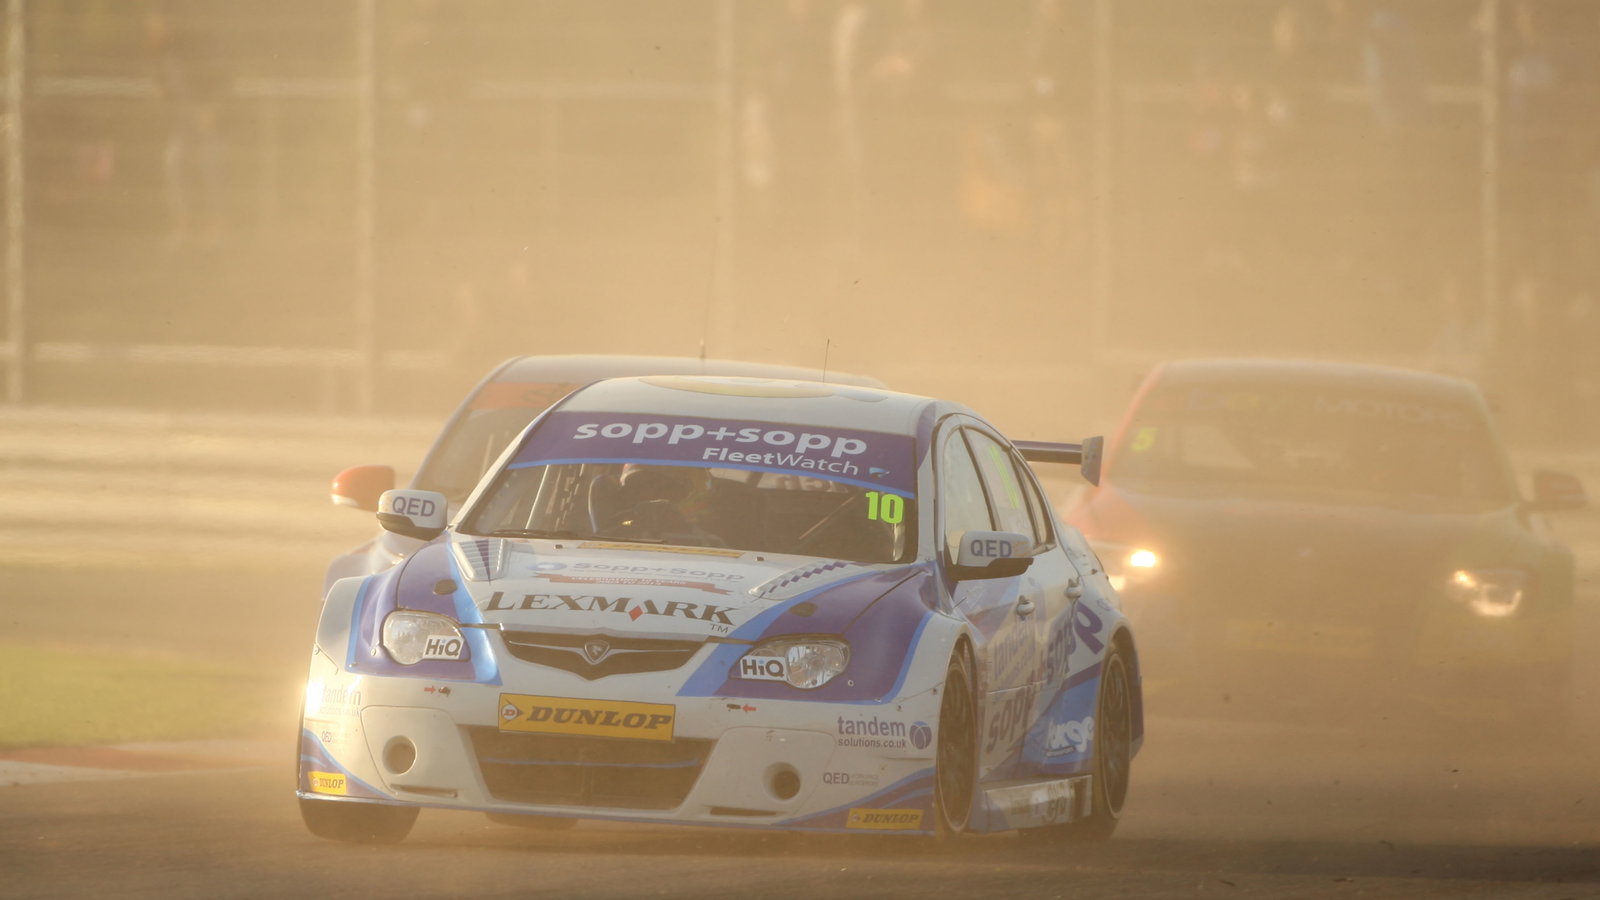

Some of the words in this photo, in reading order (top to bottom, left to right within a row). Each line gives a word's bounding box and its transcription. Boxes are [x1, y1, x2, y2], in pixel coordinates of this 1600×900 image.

[573, 421, 868, 457] sopp+sopp
[1132, 427, 1157, 450] 5
[702, 448, 860, 476] FleetWatch
[392, 494, 436, 519] QED
[865, 491, 904, 525] 10
[970, 539, 1012, 558] QED
[485, 591, 737, 627] LEXMARK
[425, 635, 461, 658] HiQ
[742, 656, 784, 678] HiQ
[527, 705, 672, 730] DUNLOP
[837, 715, 906, 737] tandem
[837, 737, 907, 750] solutions.co.uk
[822, 772, 849, 785] QED
[862, 813, 920, 825] DUNLOP
